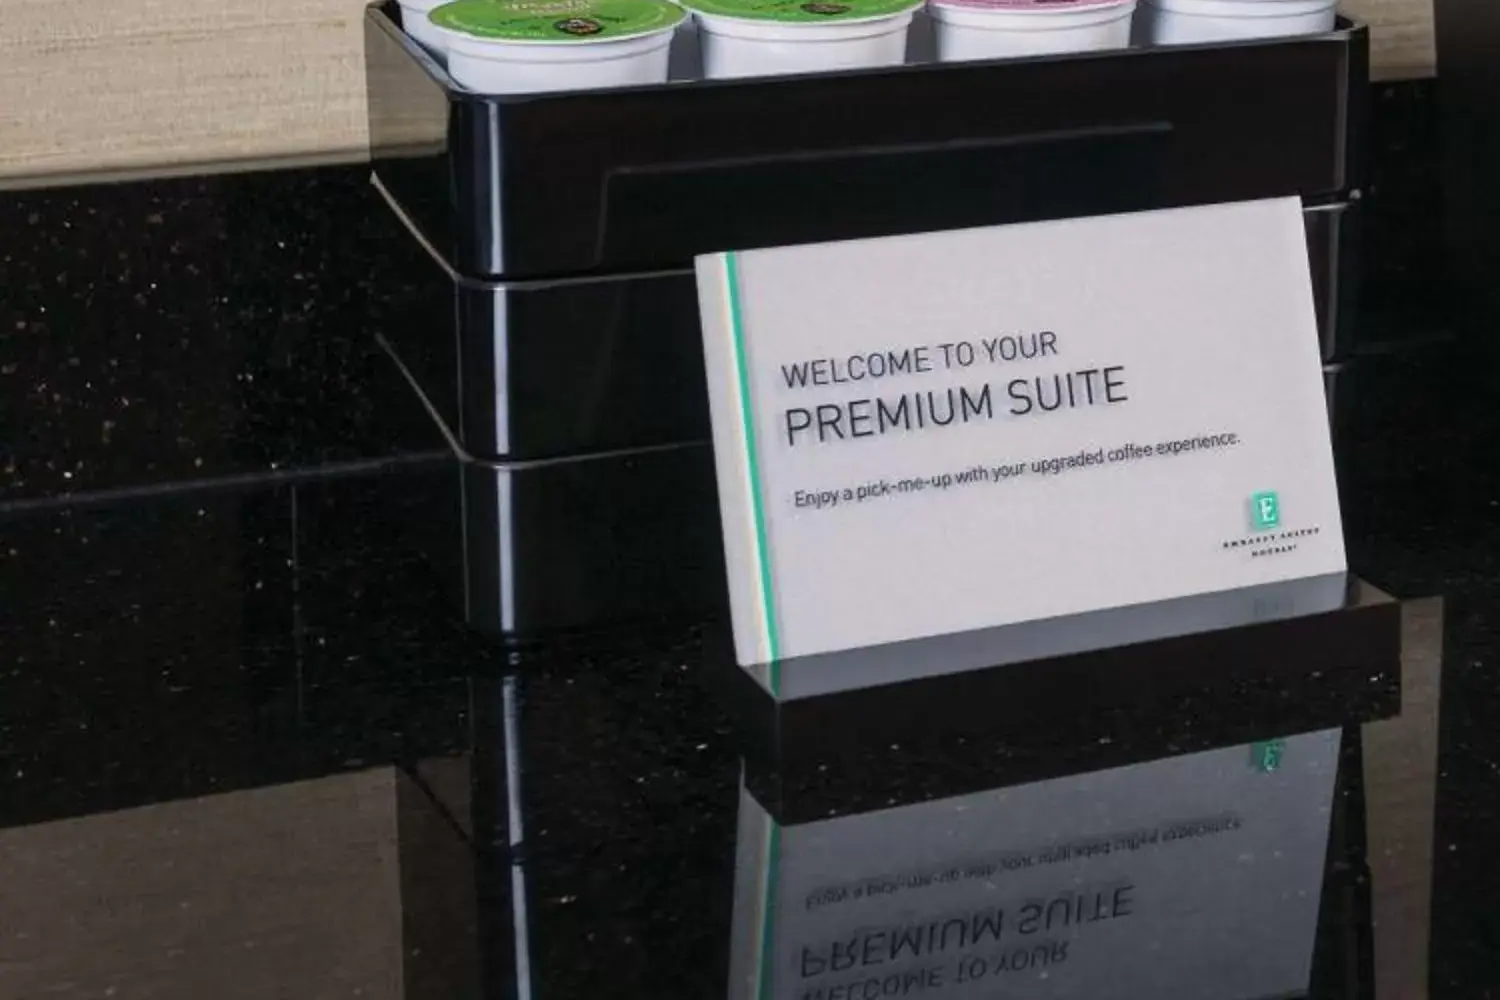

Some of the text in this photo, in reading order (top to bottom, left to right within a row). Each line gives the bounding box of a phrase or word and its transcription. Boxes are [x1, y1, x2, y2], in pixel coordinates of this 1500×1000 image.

[781, 331, 1058, 388] WELCOME TO YOUR
[785, 365, 1129, 446] PREMIUM SUITE
[794, 432, 1241, 509] Enjoy a pick-me-up with your upgraded coffee experience.
